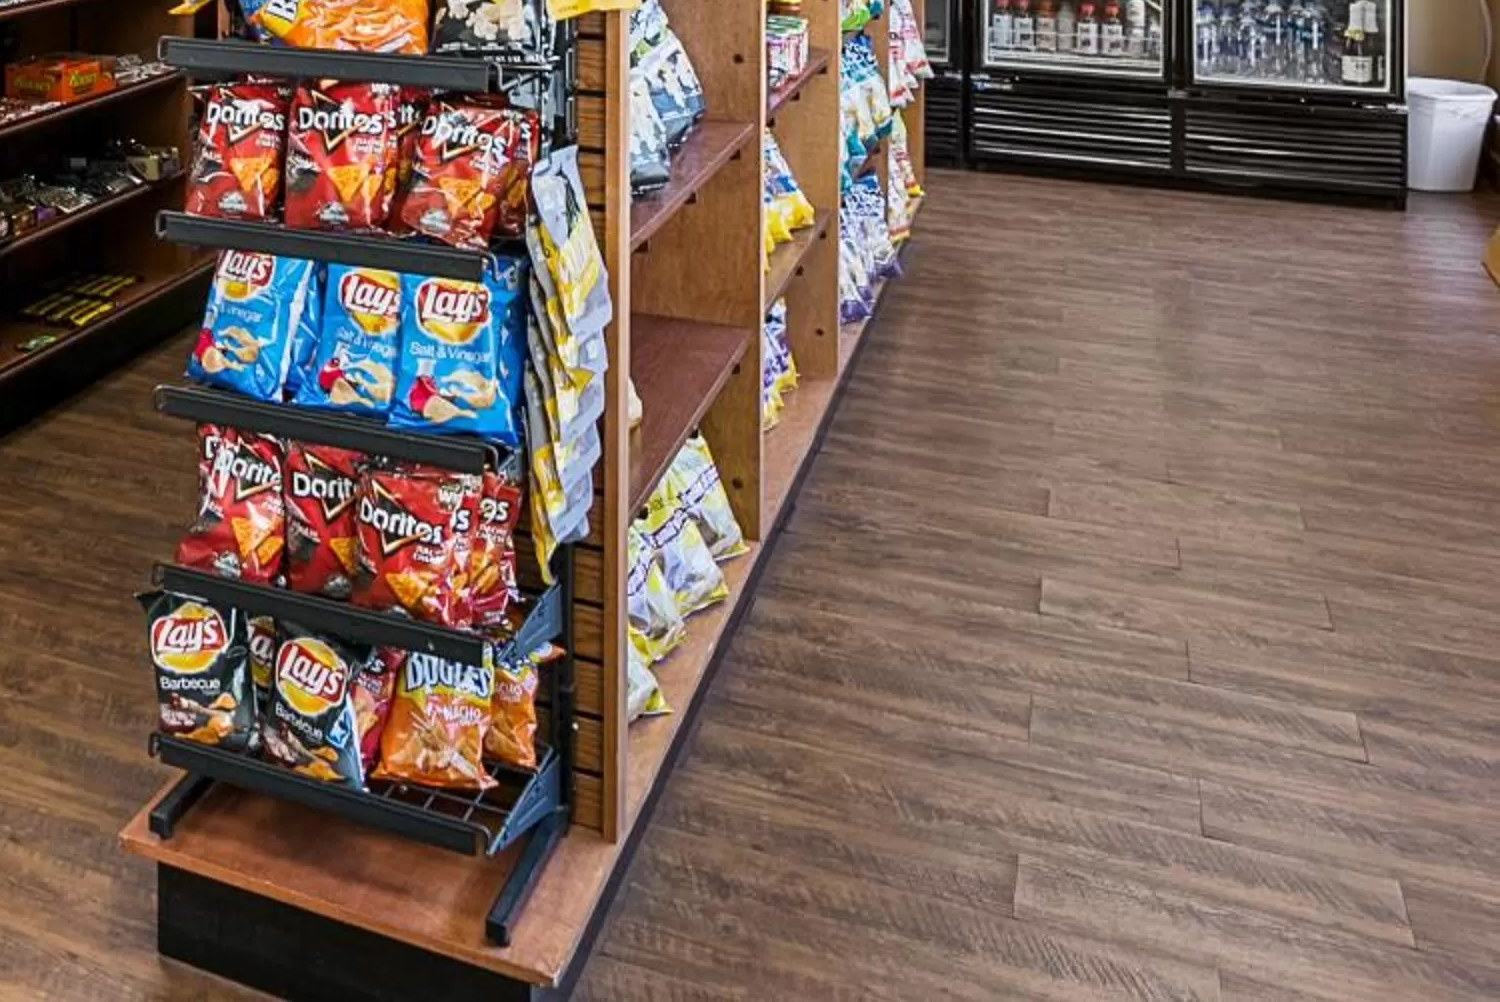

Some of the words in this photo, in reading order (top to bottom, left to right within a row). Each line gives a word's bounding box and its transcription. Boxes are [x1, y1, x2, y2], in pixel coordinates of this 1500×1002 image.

[206, 101, 285, 131] Doritos
[299, 107, 383, 134] Doritos
[410, 341, 435, 357] Salt
[160, 676, 221, 690] Barbecue
[275, 701, 323, 740] Barbecue
